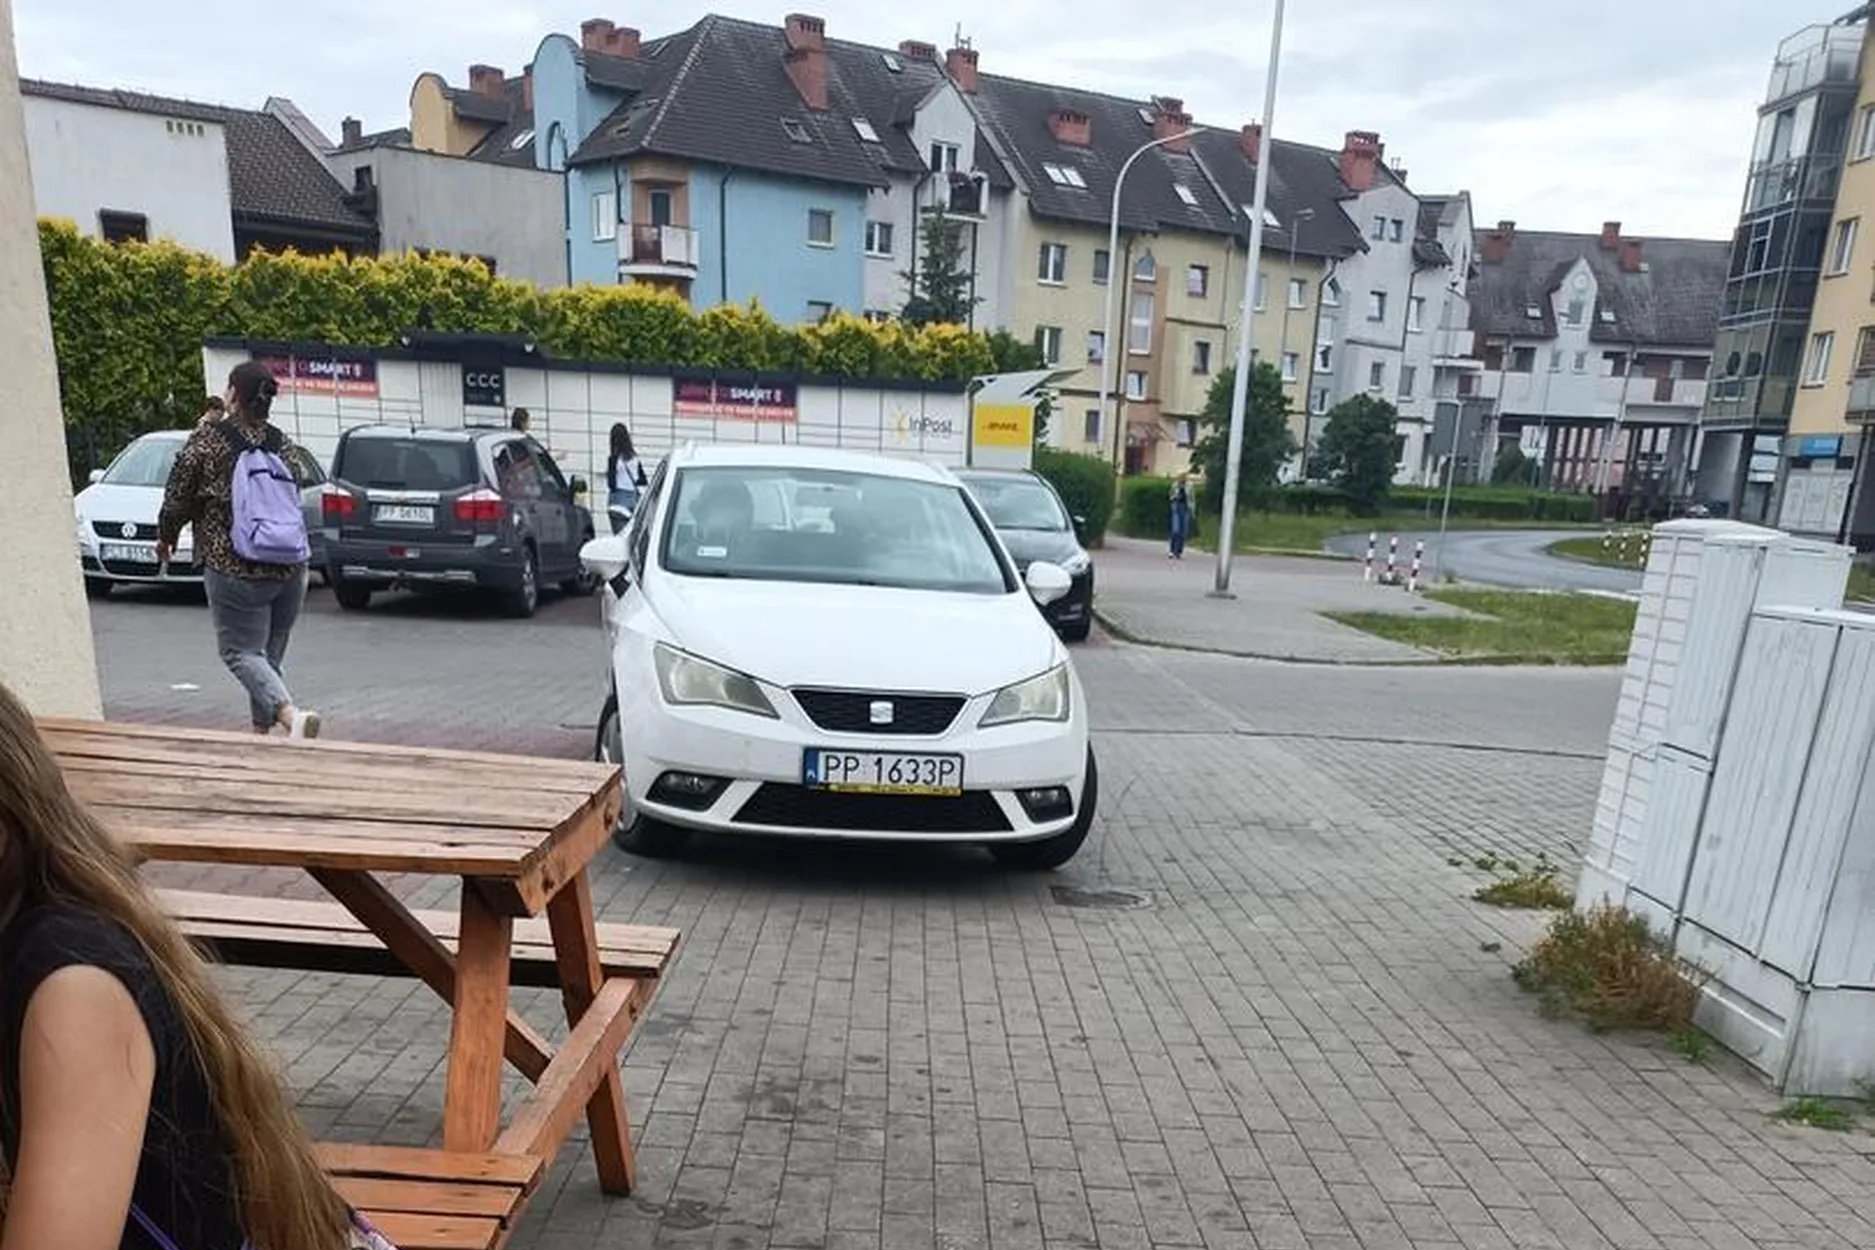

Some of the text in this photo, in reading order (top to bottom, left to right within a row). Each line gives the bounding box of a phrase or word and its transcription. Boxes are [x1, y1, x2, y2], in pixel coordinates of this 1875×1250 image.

[466, 372, 501, 389] CCC
[909, 414, 953, 433] InPost
[824, 754, 956, 786] PP 1633P
